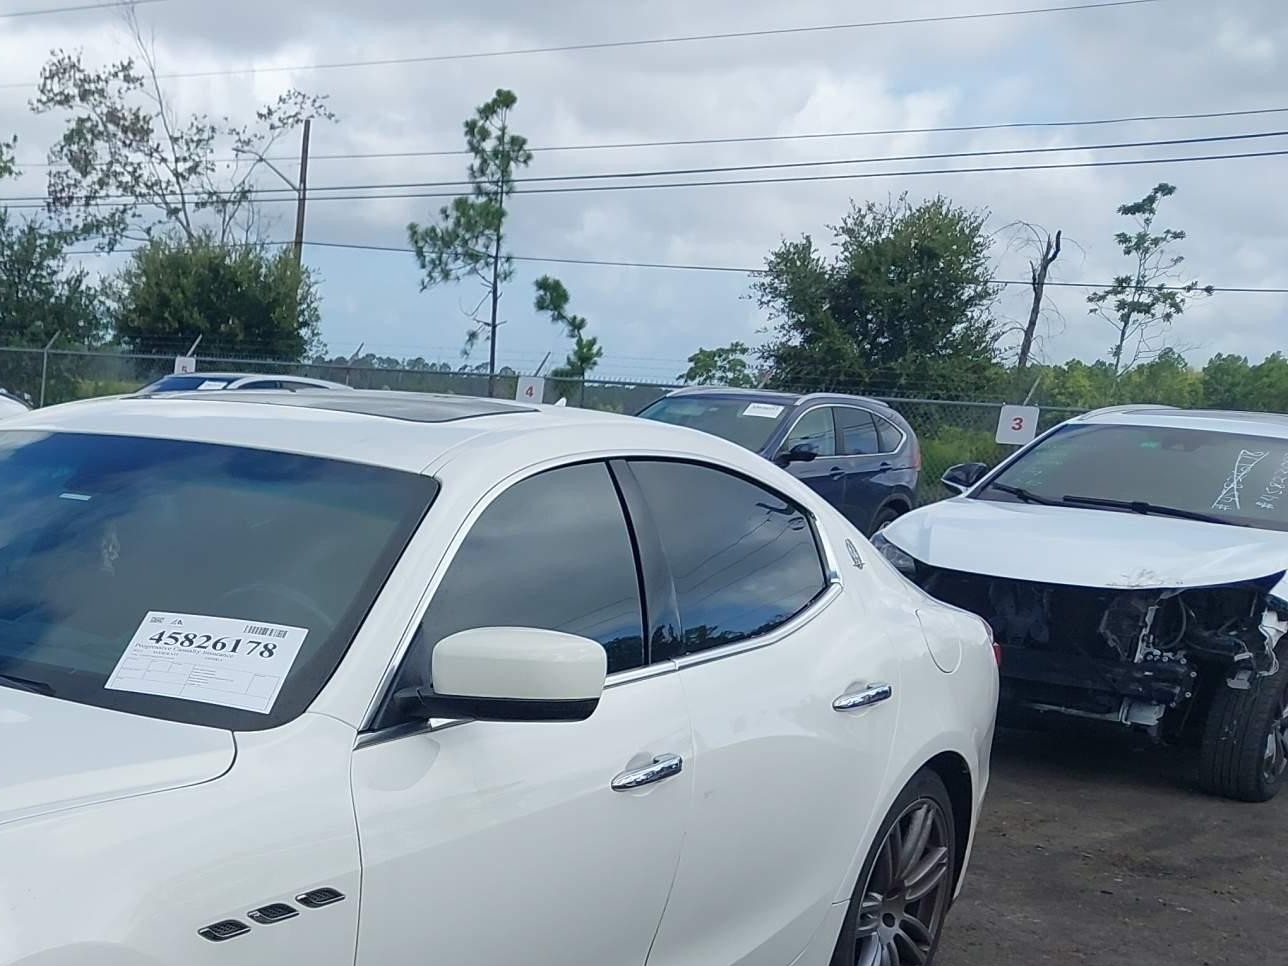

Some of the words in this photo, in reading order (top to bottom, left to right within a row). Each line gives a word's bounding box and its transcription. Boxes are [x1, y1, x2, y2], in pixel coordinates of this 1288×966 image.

[525, 386, 533, 397] 4
[1011, 417, 1023, 430] 3
[149, 630, 277, 659] 45826178
